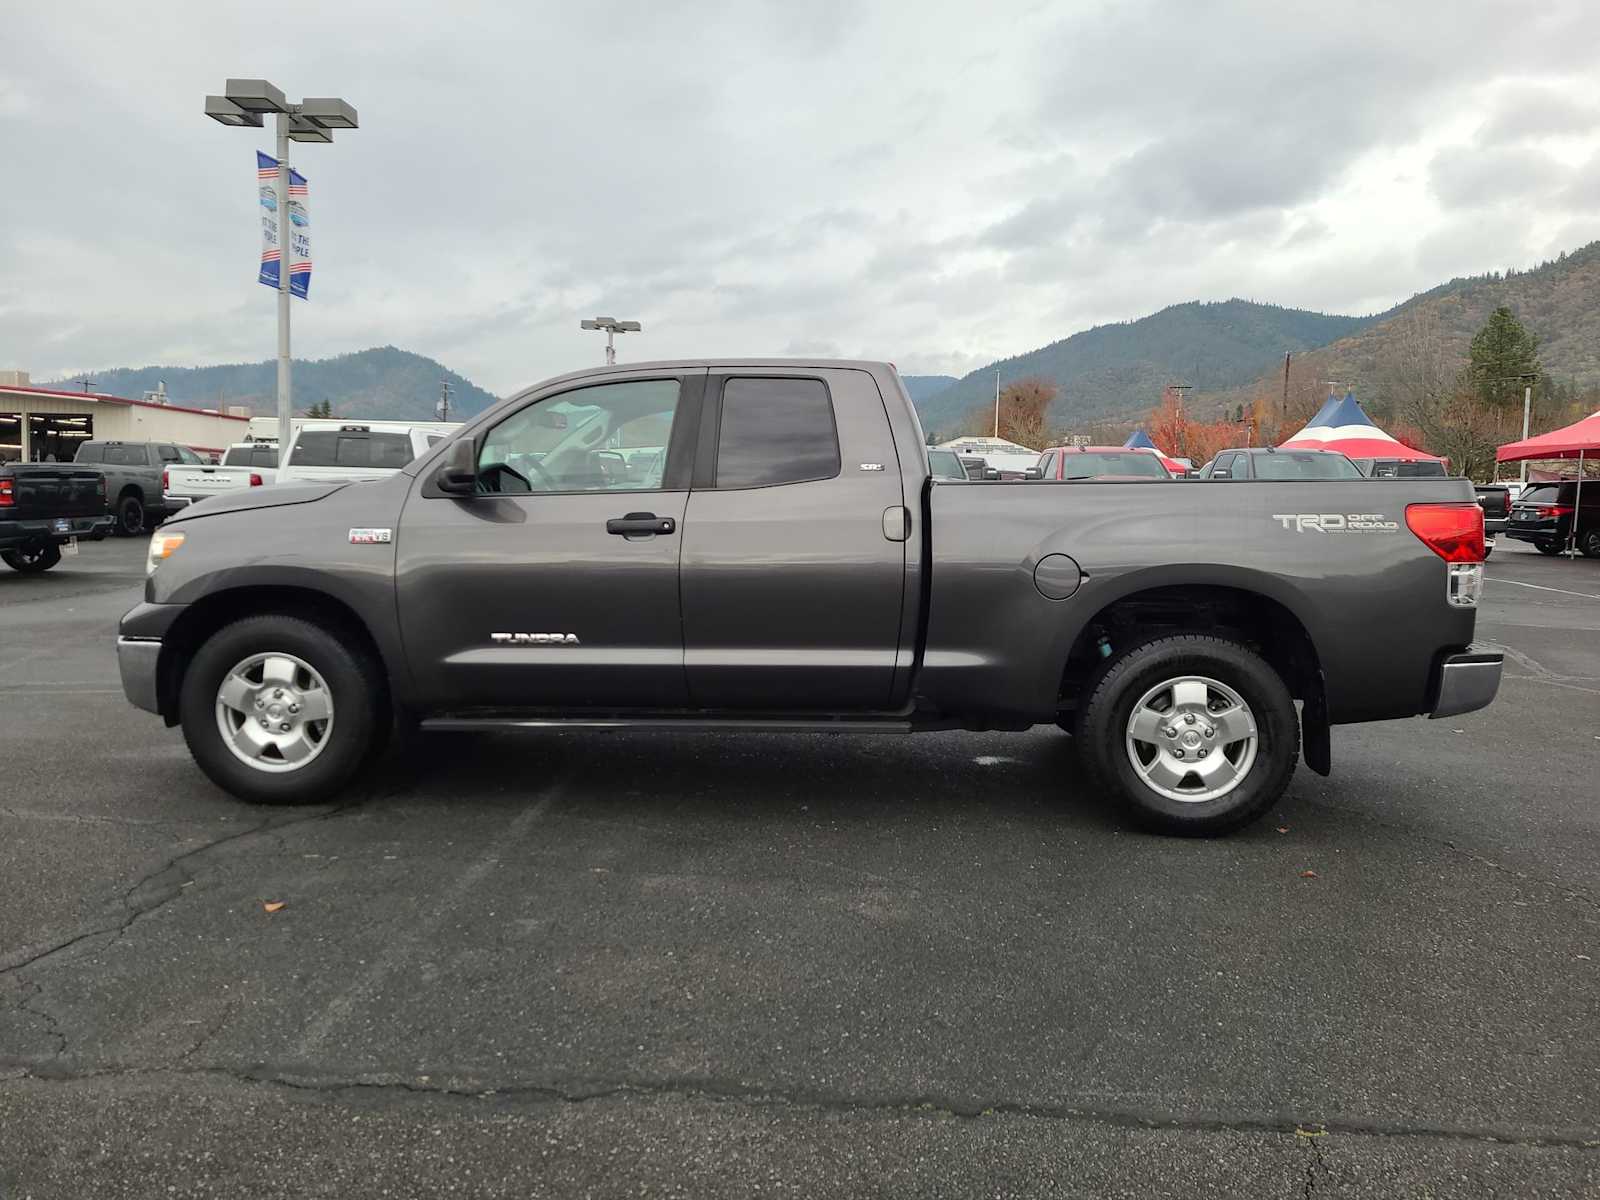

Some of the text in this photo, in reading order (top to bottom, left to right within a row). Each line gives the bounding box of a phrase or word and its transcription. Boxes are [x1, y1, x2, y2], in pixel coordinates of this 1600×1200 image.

[1272, 514, 1344, 533] TRD
[1347, 521, 1399, 530] ROAD
[490, 632, 580, 644] TUNDRA
